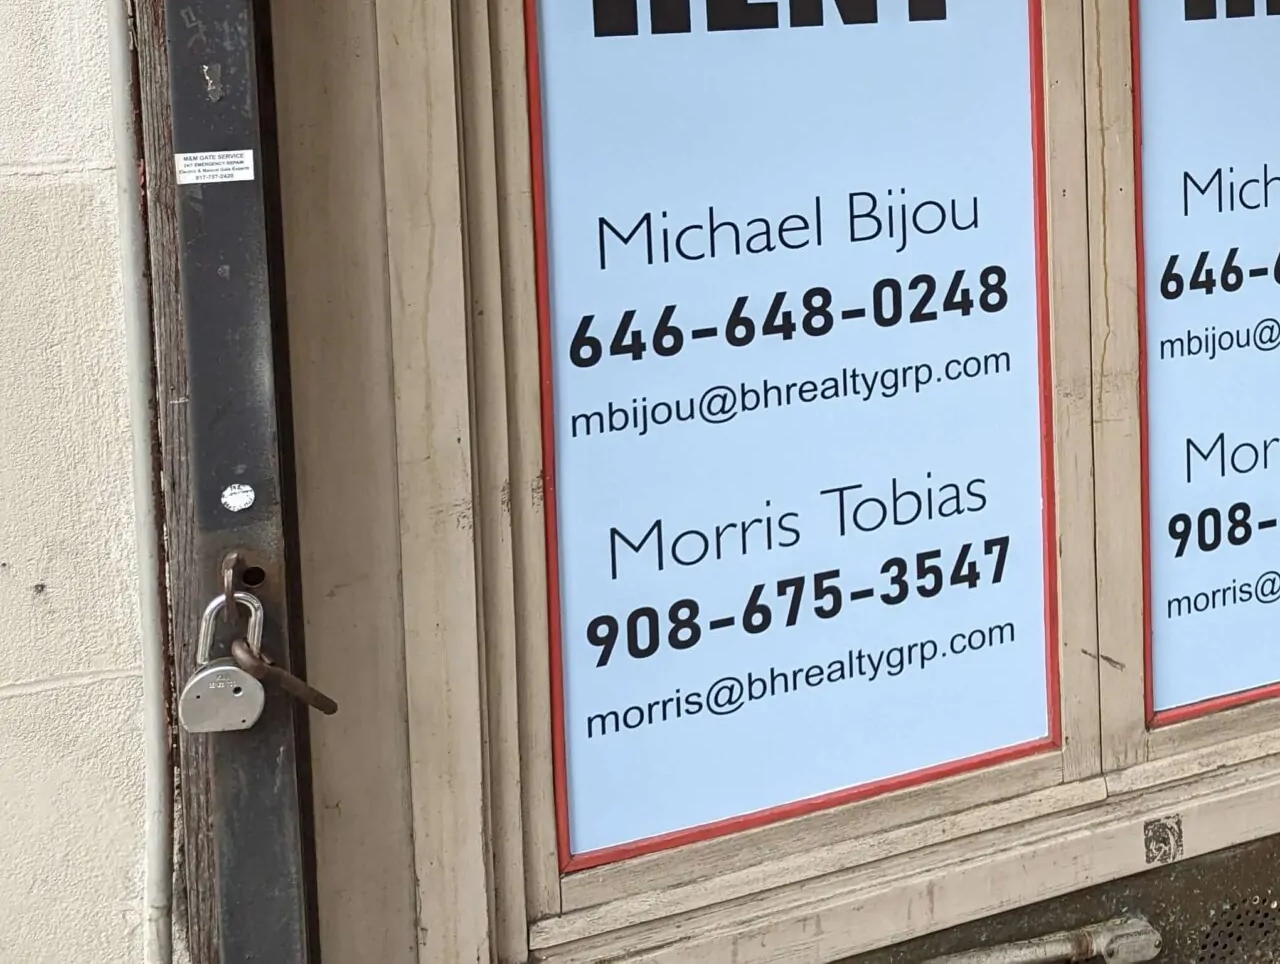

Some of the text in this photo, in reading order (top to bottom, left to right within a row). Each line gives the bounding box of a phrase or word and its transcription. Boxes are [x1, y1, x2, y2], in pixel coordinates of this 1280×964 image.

[598, 188, 978, 270] Michael Bijou
[569, 265, 1008, 368] 646-648-0248
[572, 352, 1010, 438] mbijou@bhrealtygrp.com
[610, 471, 987, 580] Morris Tobias
[587, 535, 1010, 668] 908-675-3547
[587, 622, 1015, 738] morris@bhrealtygrp.com
